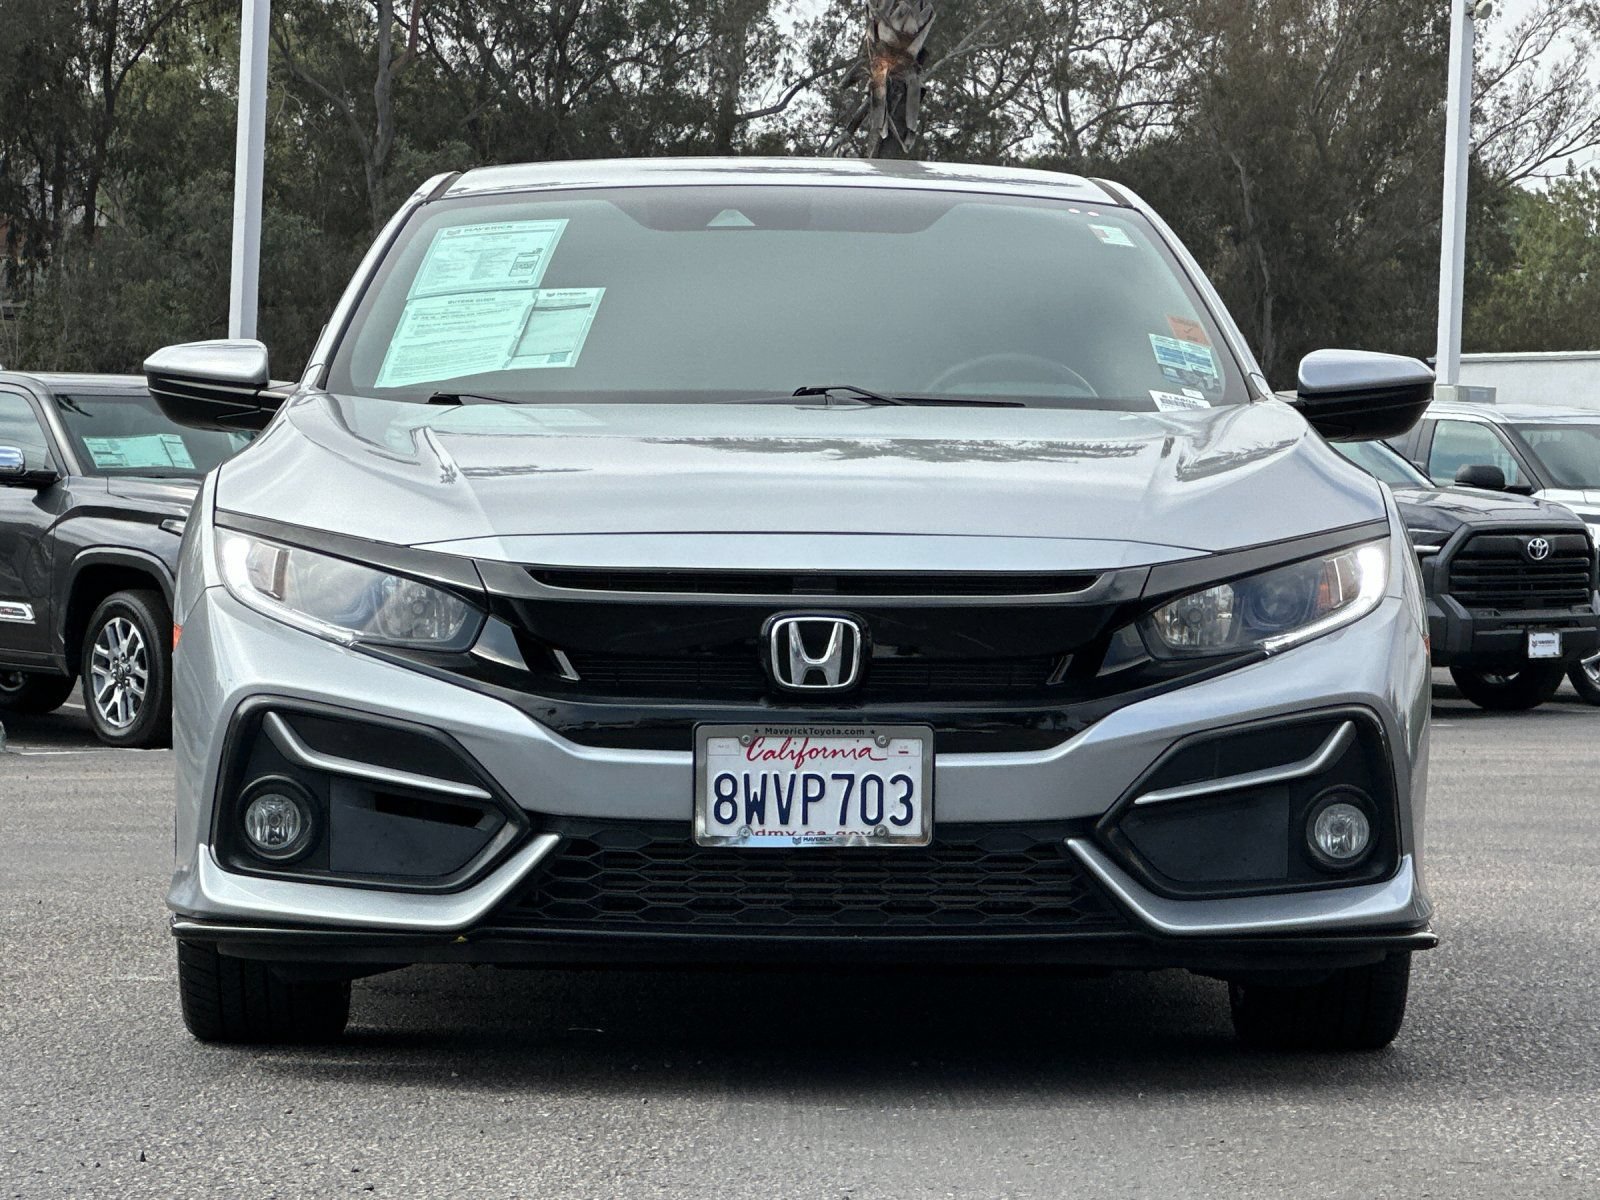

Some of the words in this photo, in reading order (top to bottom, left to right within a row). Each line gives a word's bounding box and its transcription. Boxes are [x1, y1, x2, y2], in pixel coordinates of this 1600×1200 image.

[764, 727, 865, 736] MaverickToyota.com
[746, 737, 888, 769] California
[713, 773, 914, 826] 8WVP703
